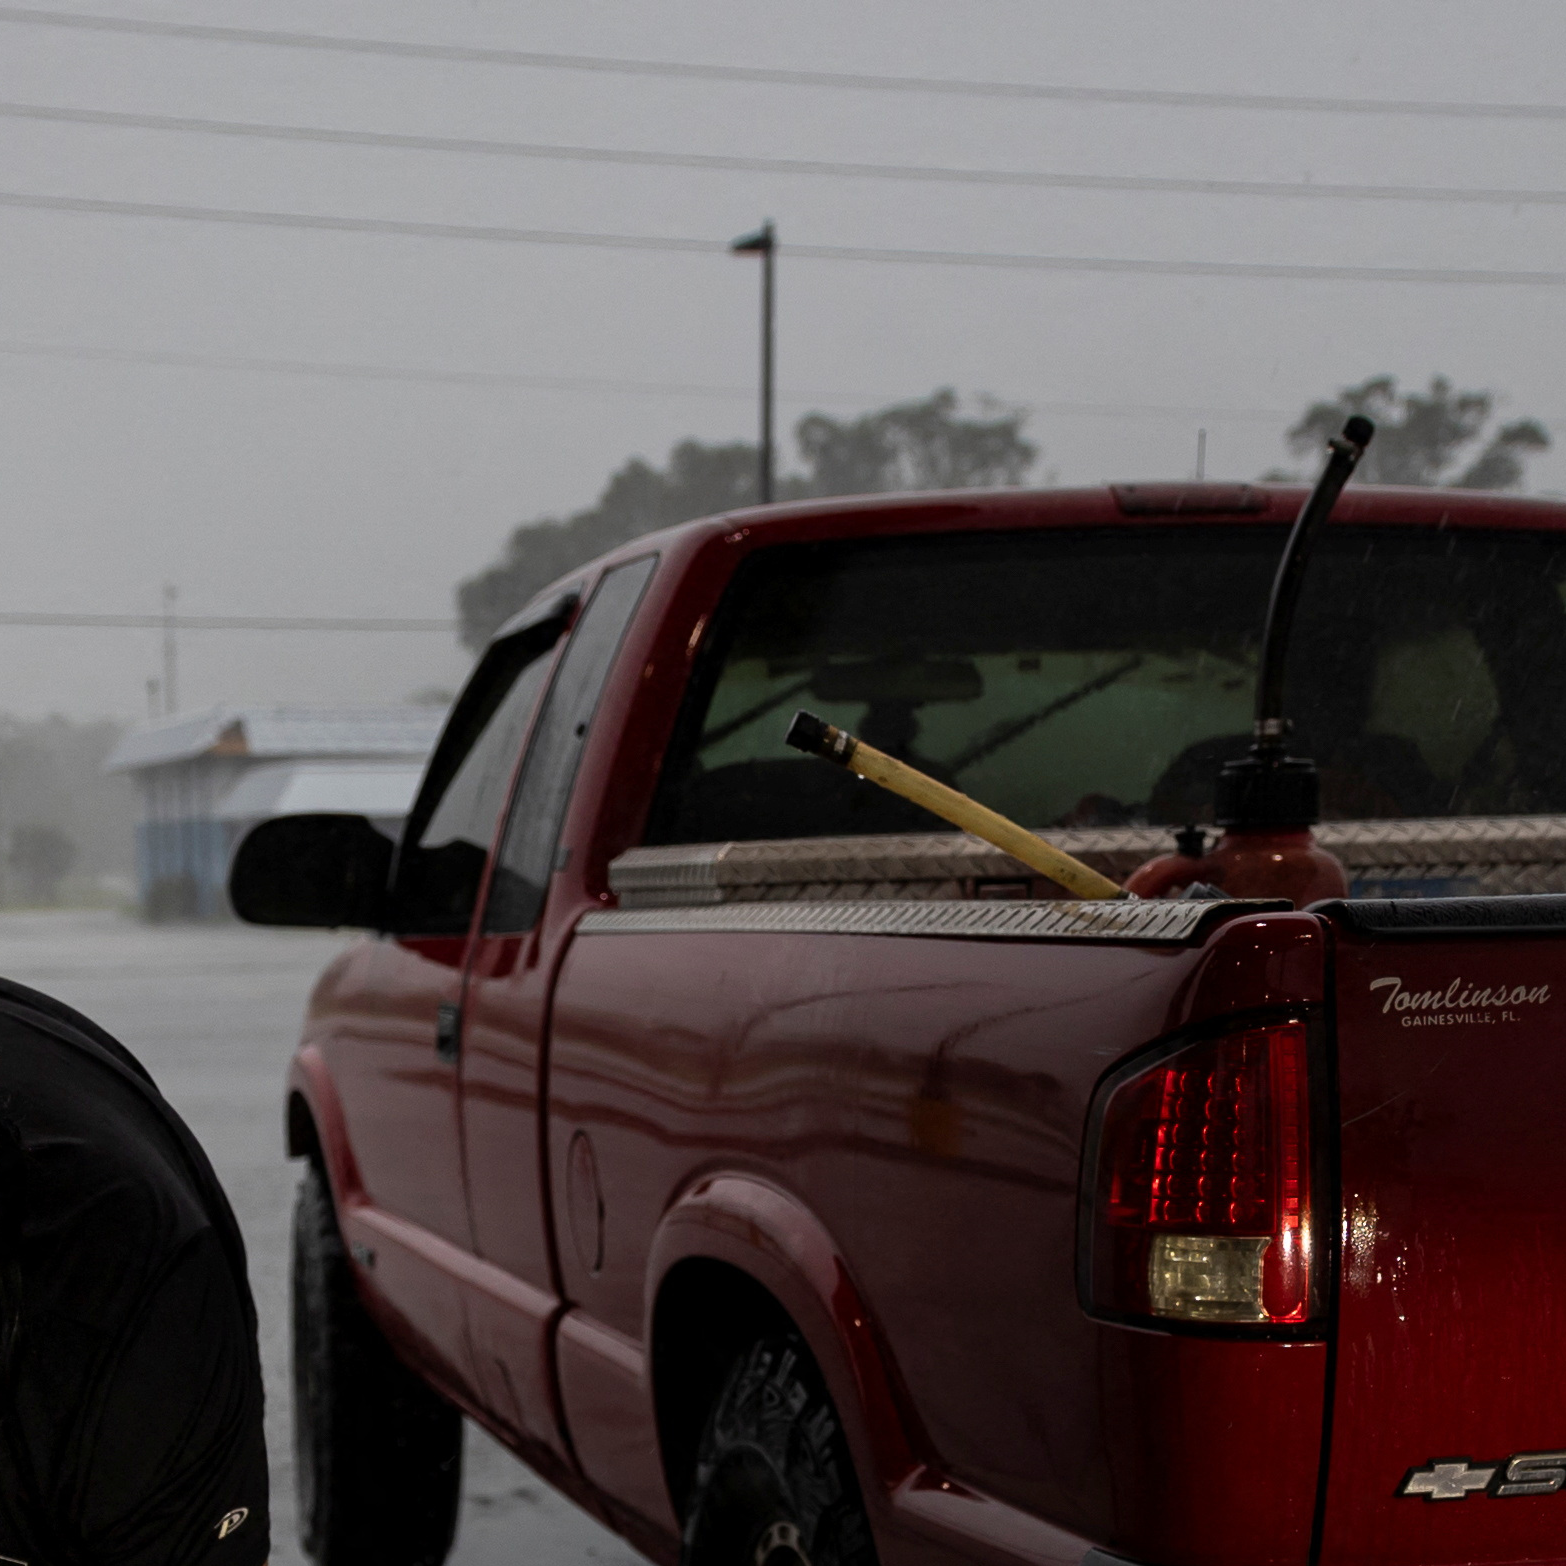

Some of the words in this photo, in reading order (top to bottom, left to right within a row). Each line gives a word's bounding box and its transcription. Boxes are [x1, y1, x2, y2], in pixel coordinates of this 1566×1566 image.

[1369, 976, 1551, 1014] Tomlinson
[1401, 1012, 1497, 1028] GAINESVILLE,
[1501, 1010, 1521, 1022] FL.
